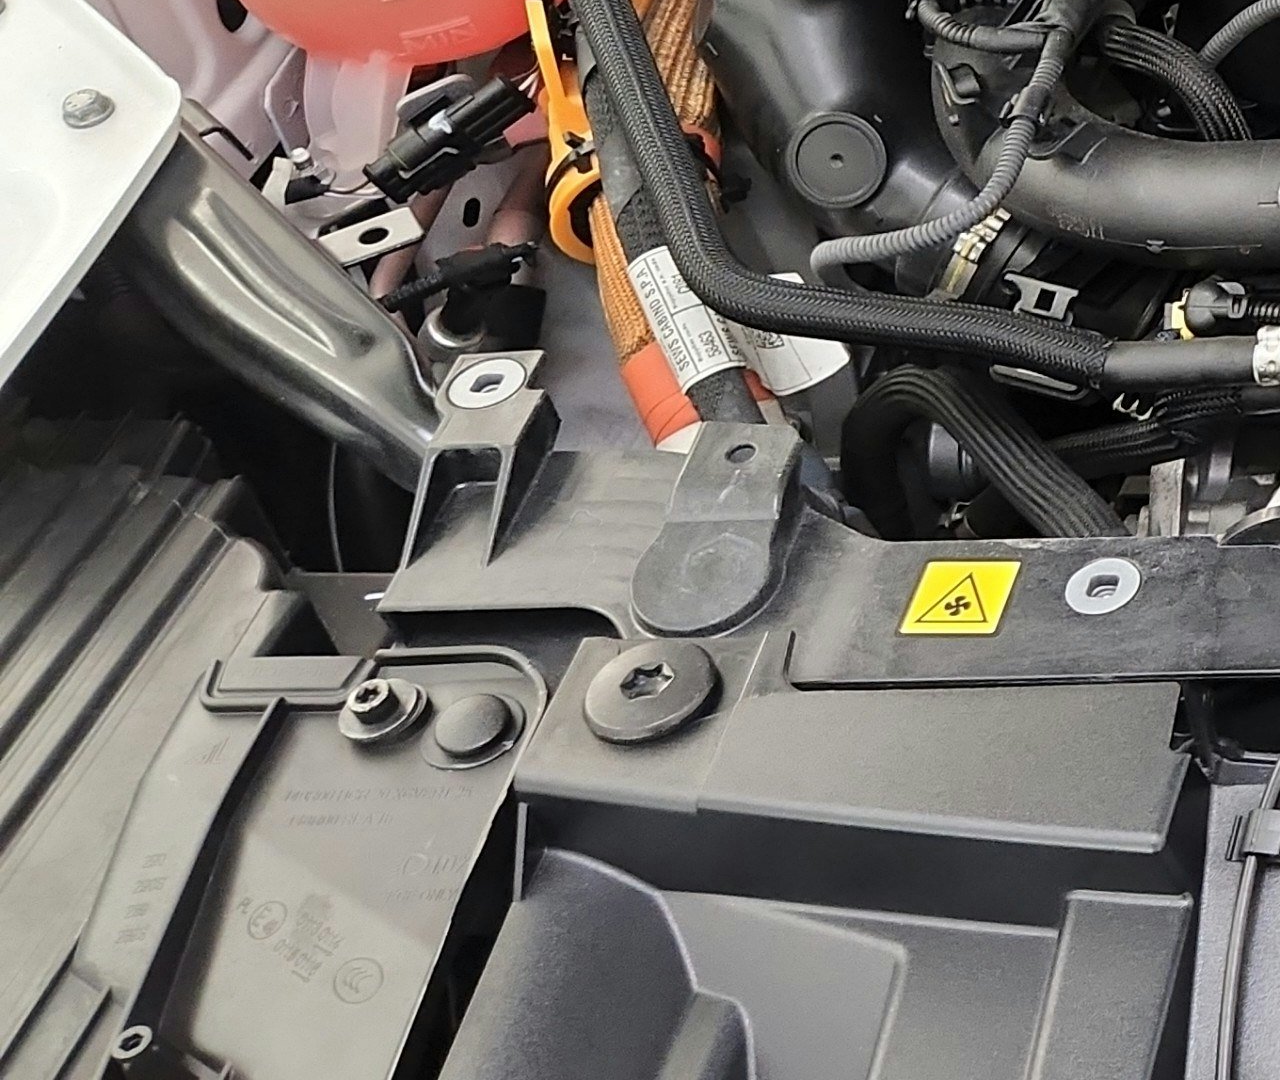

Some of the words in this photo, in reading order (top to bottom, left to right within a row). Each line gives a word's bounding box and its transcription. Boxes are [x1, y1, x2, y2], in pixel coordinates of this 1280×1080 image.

[401, 23, 479, 55] MIN
[650, 299, 671, 338] CABIND
[668, 337, 690, 373] SEWS
